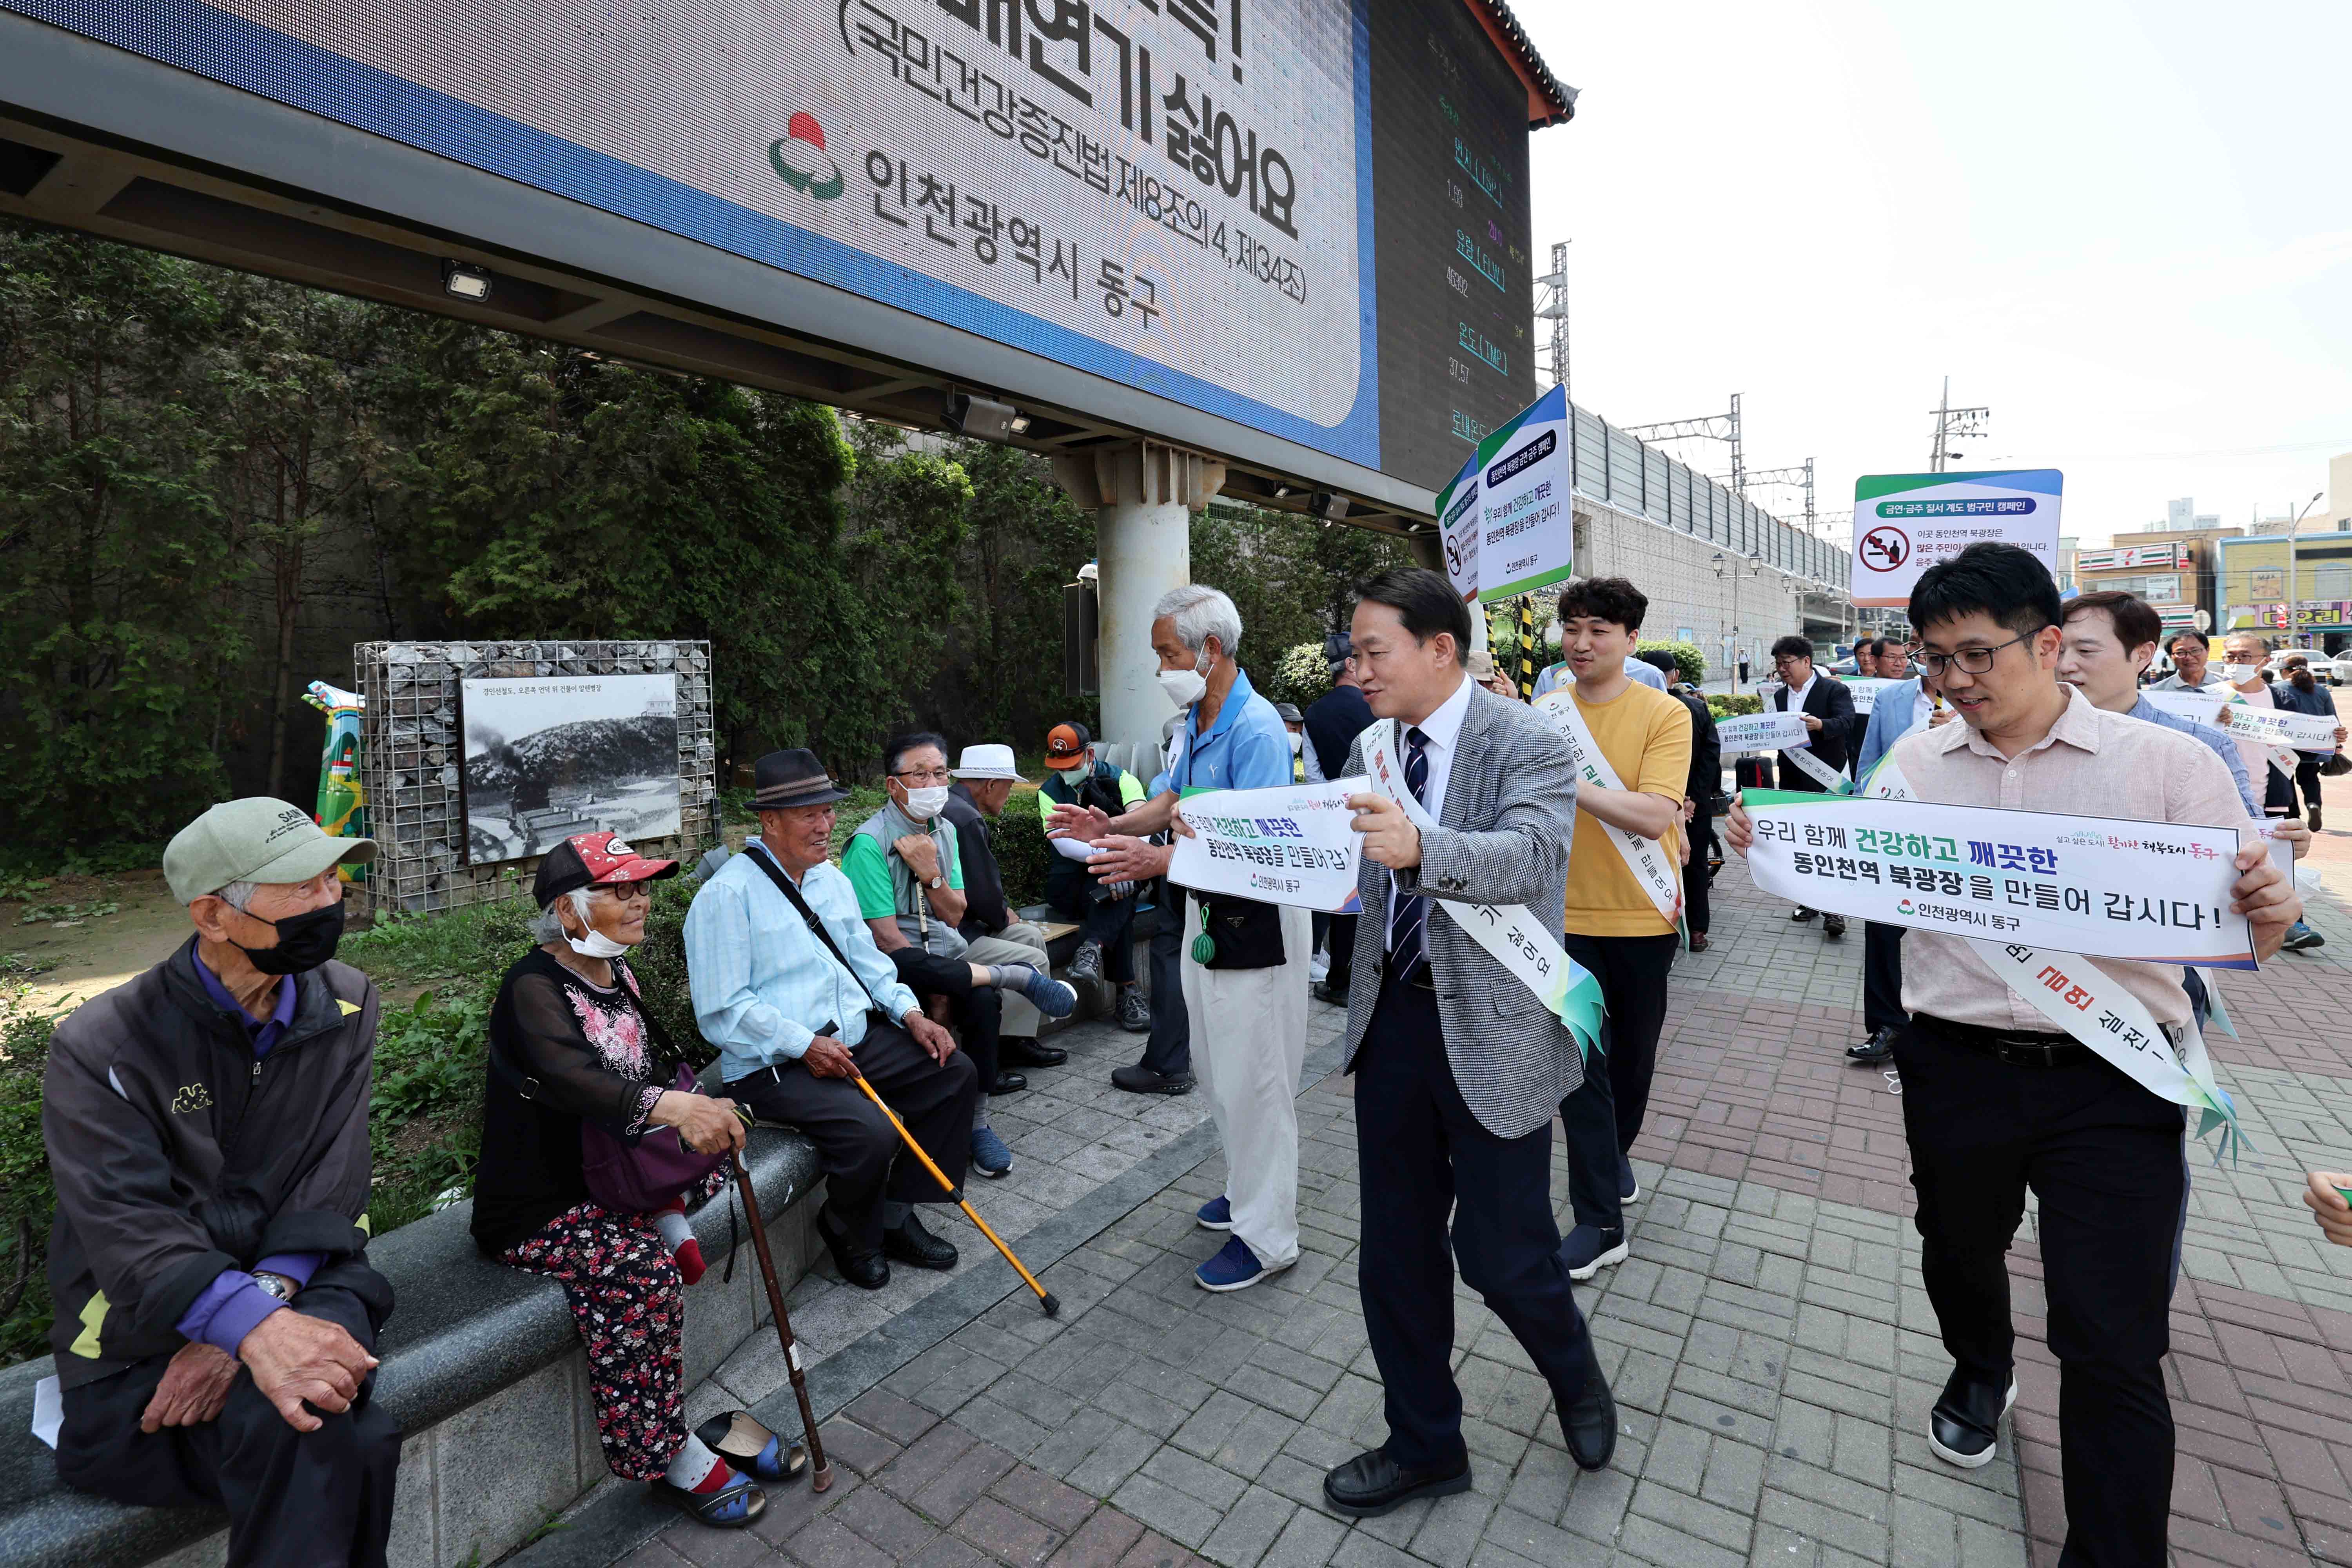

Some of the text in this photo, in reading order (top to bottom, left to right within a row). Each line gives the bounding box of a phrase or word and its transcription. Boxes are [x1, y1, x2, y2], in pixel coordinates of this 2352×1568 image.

[1162, 73, 1298, 241] 싫어요
[866, 150, 1159, 329] 인천광역시 동구
[1236, 229, 1306, 305] 제34조)
[1491, 464, 1506, 483] 동인천역
[1507, 457, 1519, 473] 북광장
[1537, 436, 1551, 455] 캠페인
[1493, 506, 1502, 522] 우리
[1503, 501, 1512, 517] 함께
[1513, 490, 1534, 513] 건강하고
[1534, 479, 1552, 501] 깨끗한
[1885, 501, 2025, 514] 금연·금주 질서 계도 범구민 캠페인
[1486, 526, 1504, 546] 동인천역
[1505, 518, 1525, 537] 북광장을
[1525, 511, 1540, 529] 만들어
[1918, 529, 2004, 538] 이곳 동인천역 북광장은
[1916, 544, 1933, 553] 많은
[1511, 554, 1537, 572] 인천광역시 동구
[1916, 558, 1933, 566] 음주
[483, 687, 516, 696] 경인선철도,
[1739, 722, 1759, 732] 건강하고
[1760, 721, 1776, 730] 깨끗한
[2230, 720, 2261, 733] 광장을
[2232, 711, 2253, 722] 하고
[1724, 734, 1743, 742] 동인천역
[1744, 732, 1764, 740] 북광장을
[1765, 731, 1781, 739] 만들어
[1212, 817, 1260, 839] 건강하고
[1255, 817, 1304, 838] 깨끗한
[1206, 838, 1244, 862] 동인천역
[1240, 843, 1284, 867] 북광장을
[1286, 844, 1328, 869] 만들어
[1757, 819, 2058, 875] 우리 함께 건강하고 깨끗한
[2107, 836, 2139, 850] 활기찬
[2141, 840, 2186, 855] 행복도시
[2188, 842, 2220, 860] 동구
[1258, 875, 1301, 893] 인천광역시 동구
[1641, 853, 1673, 902] 만들어요
[1793, 851, 1880, 884] 동인천역
[1889, 864, 1994, 901] 북광장을
[2005, 879, 2090, 915] 만들어
[1918, 902, 2020, 931] 인천광역시 동구
[1507, 926, 1551, 977] 싫어요
[2036, 965, 2095, 1012] 금연
